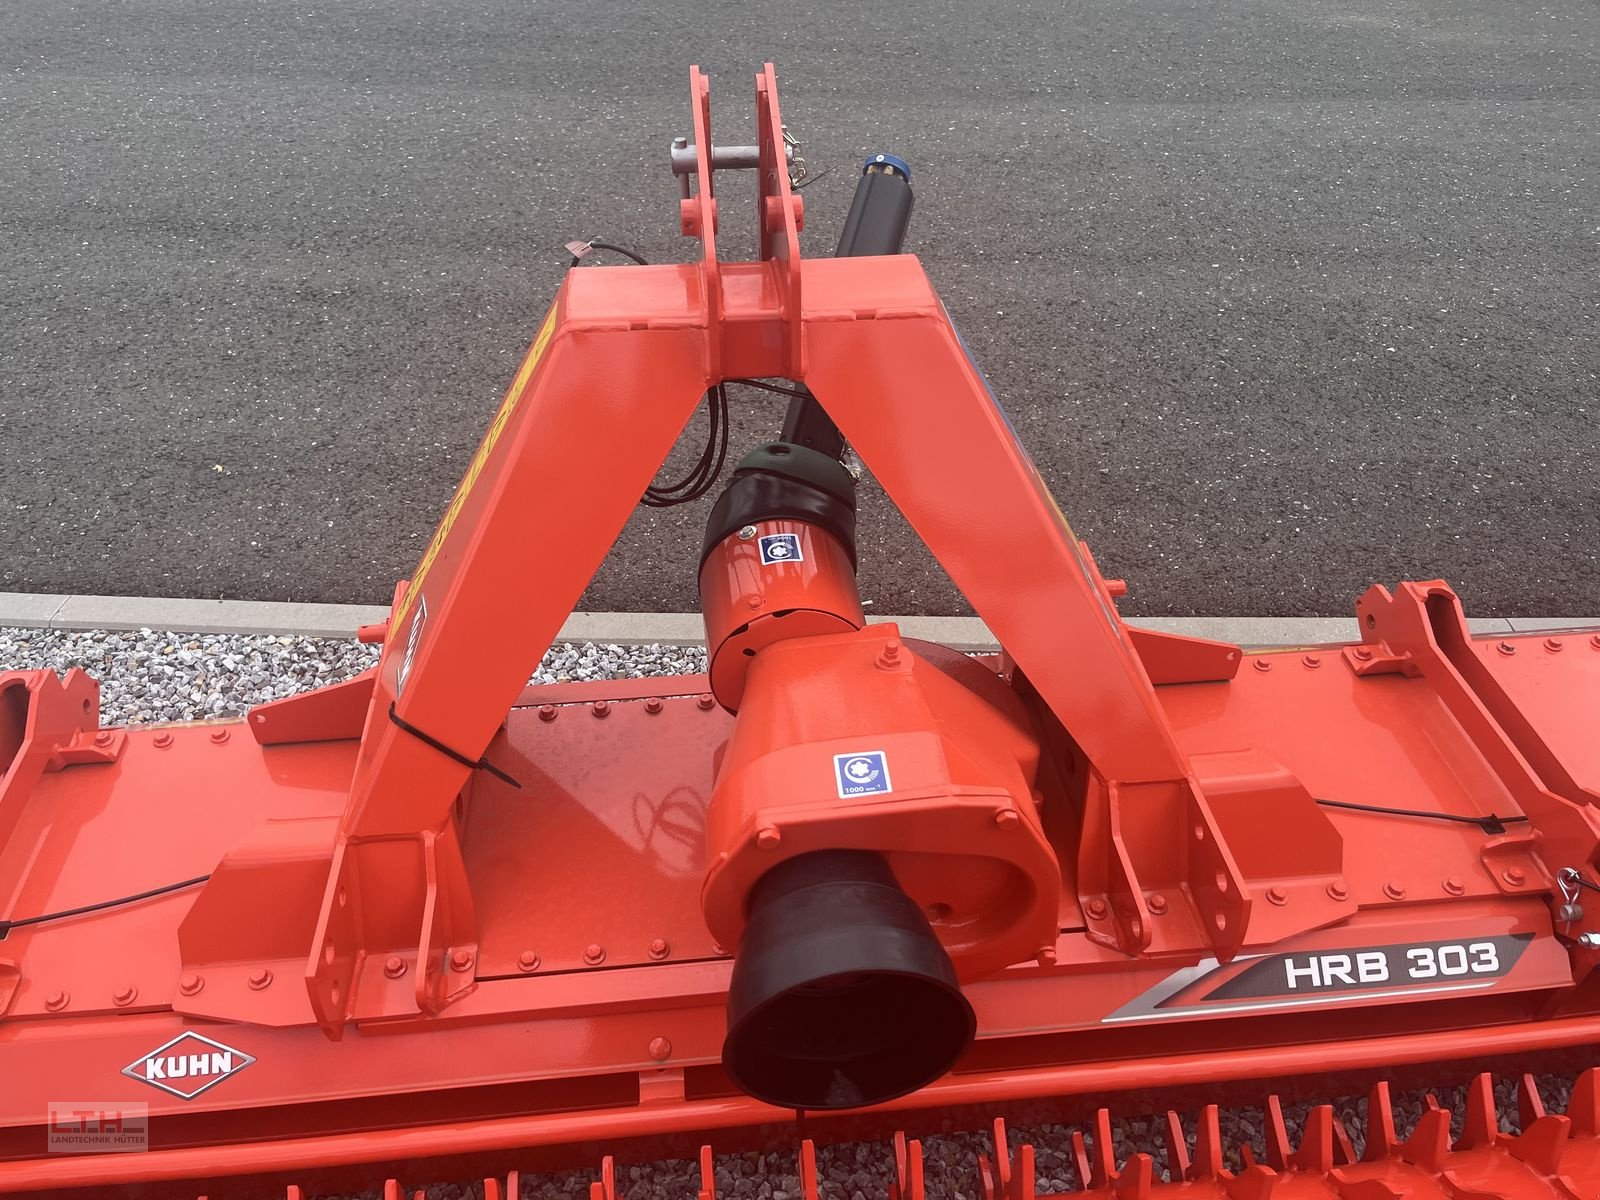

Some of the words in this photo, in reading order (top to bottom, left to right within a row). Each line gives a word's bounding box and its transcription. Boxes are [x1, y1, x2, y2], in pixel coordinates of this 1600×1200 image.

[1284, 951, 1390, 989] HRB
[1406, 942, 1500, 979] 303
[146, 1051, 232, 1080] KUHN
